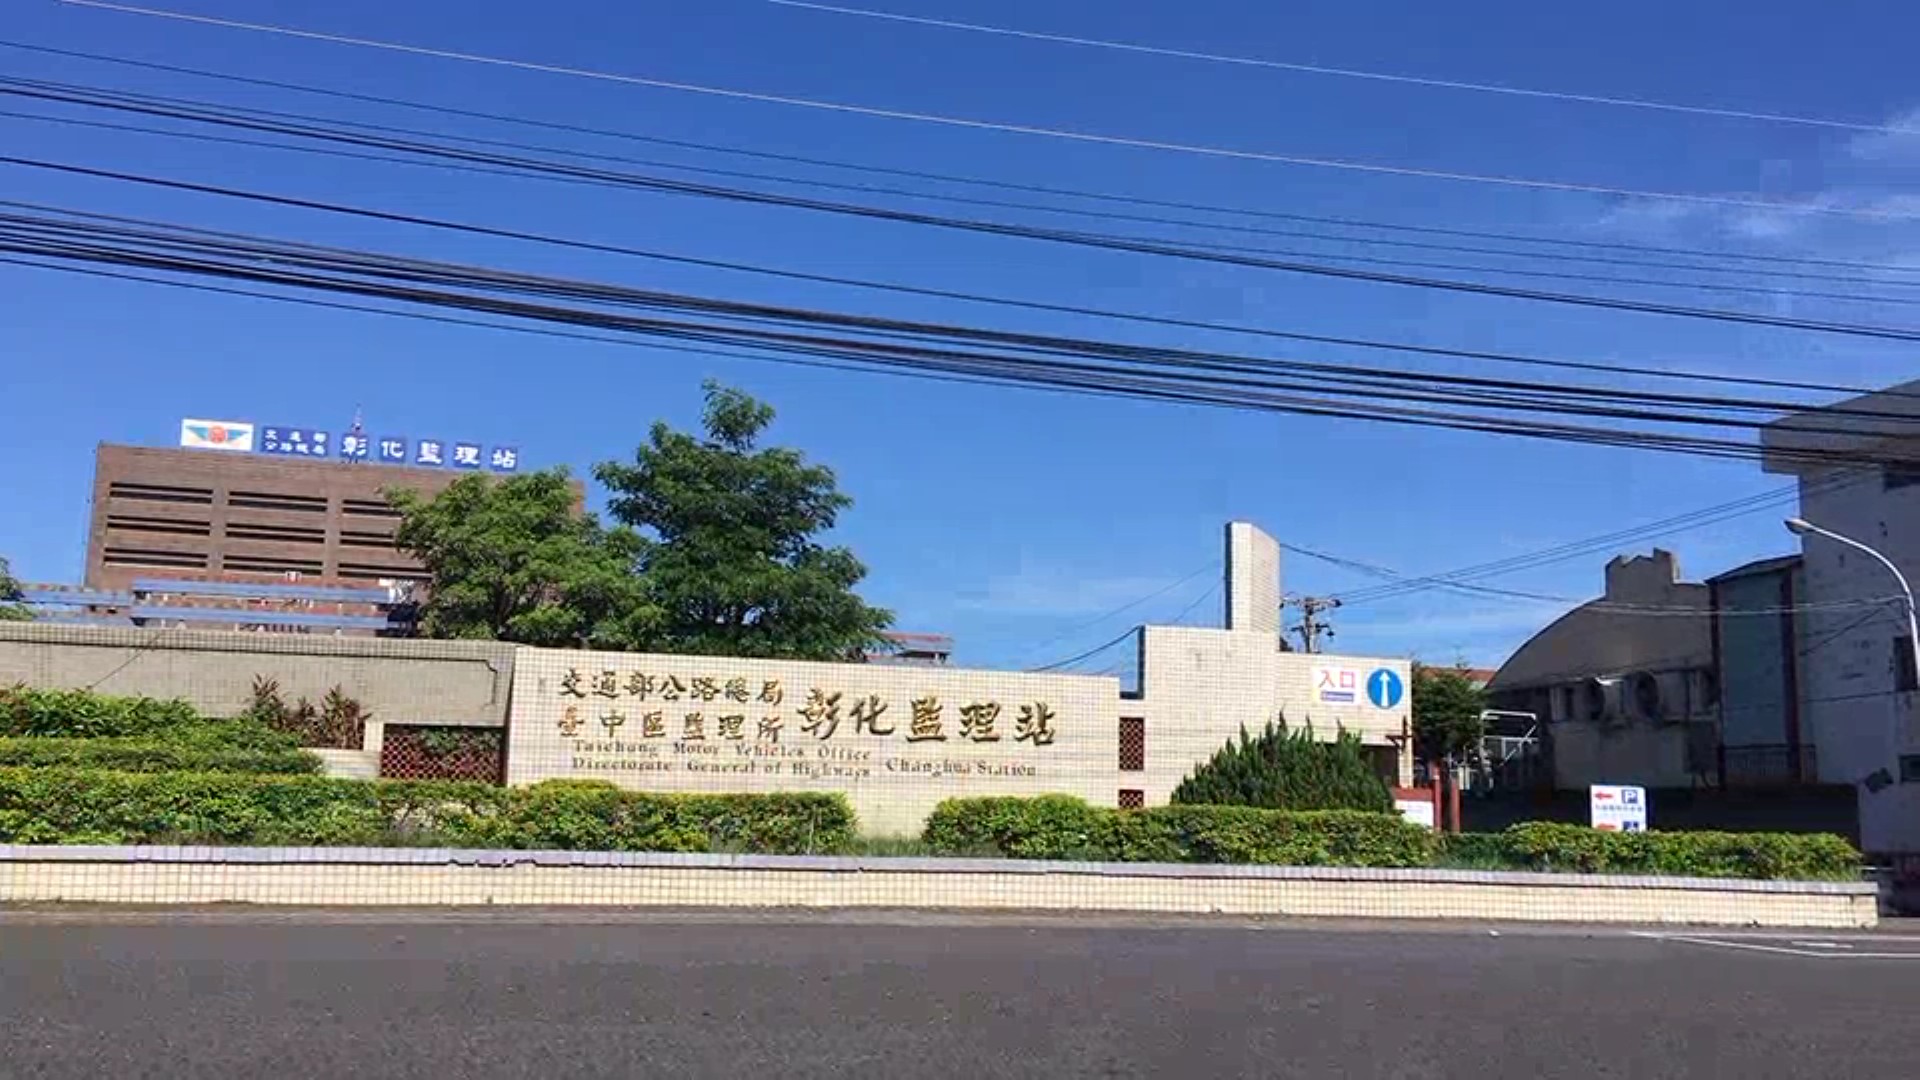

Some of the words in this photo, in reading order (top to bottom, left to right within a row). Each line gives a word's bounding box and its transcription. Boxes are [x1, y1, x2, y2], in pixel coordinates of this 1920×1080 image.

[342, 436, 516, 468] 彰化監理站
[560, 669, 783, 705] 交通部公路總局
[1319, 670, 1355, 688] 入口
[796, 687, 1055, 746] 彰化監理站
[575, 740, 657, 758] Taichung
[673, 741, 719, 755] Motor
[736, 742, 804, 757] Vehicles
[818, 745, 870, 760] Office
[573, 757, 671, 771] Directorate
[687, 758, 755, 773] General
[765, 761, 780, 774] of
[793, 762, 870, 781] Highways
[885, 757, 971, 777] Changhua
[976, 760, 1036, 776] Station
